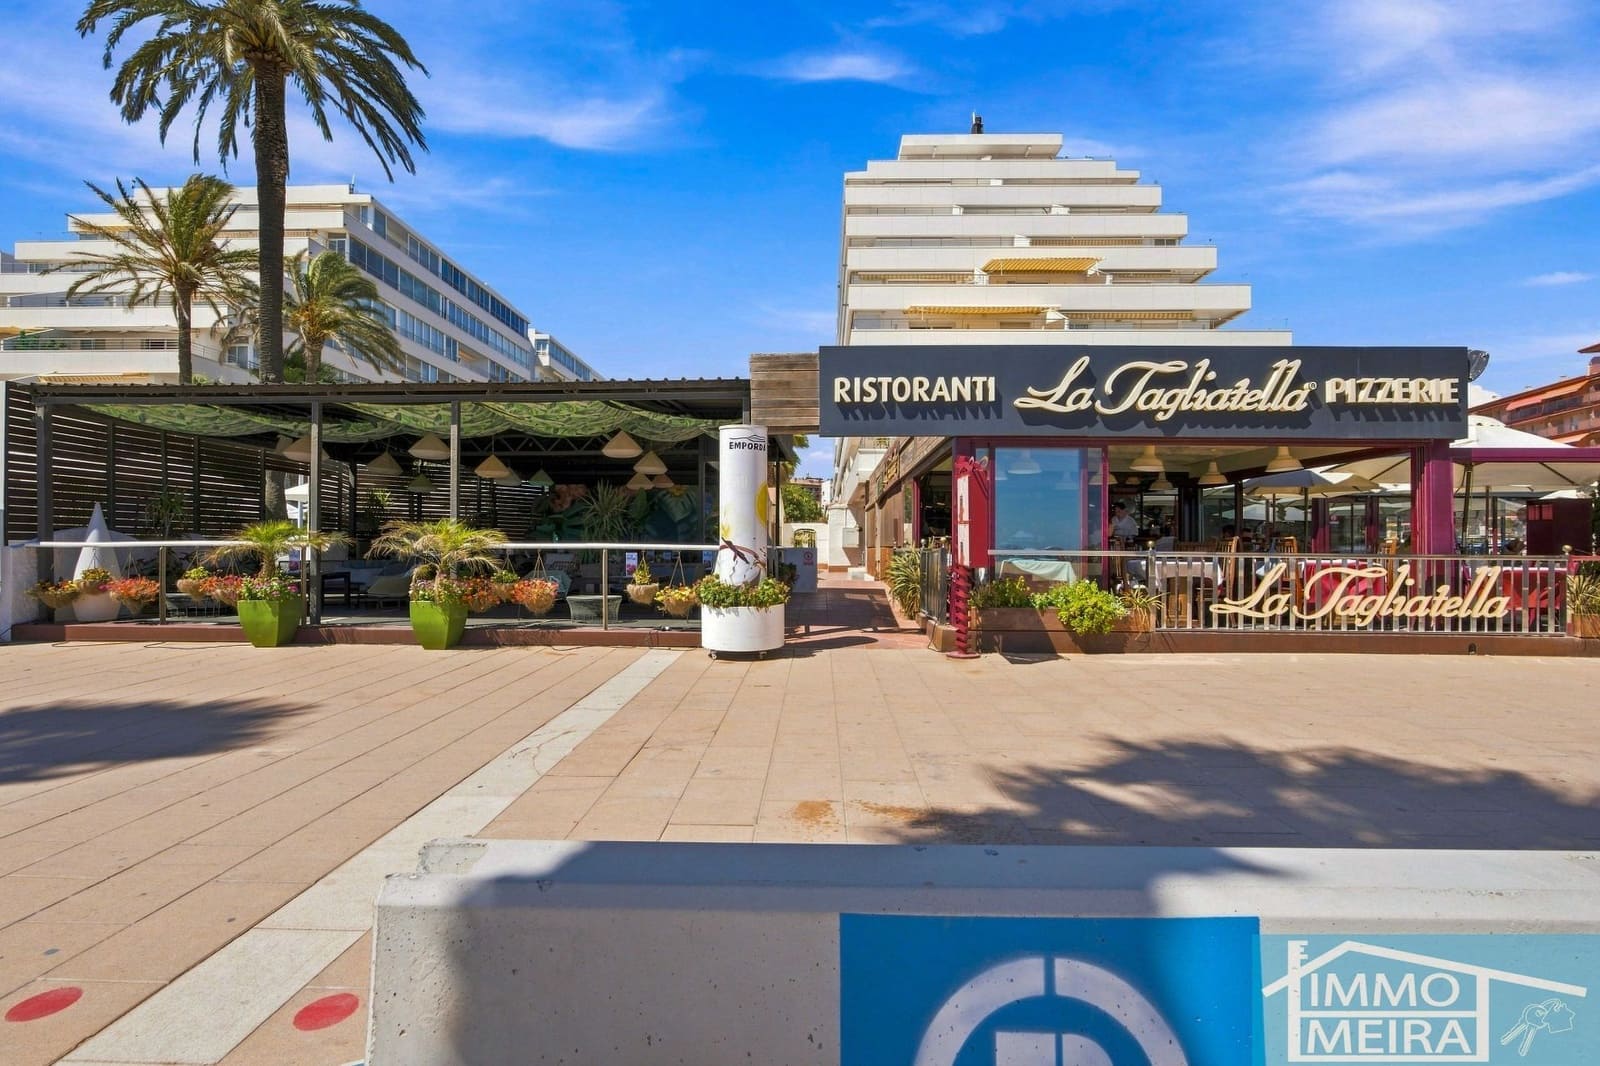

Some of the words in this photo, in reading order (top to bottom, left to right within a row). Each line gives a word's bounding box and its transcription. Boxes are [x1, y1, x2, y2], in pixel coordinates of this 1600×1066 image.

[834, 376, 996, 403] RISTORANTI
[1013, 355, 1095, 413] La
[1325, 377, 1460, 404] PIZZERIE
[1209, 562, 1292, 618] La
[1292, 564, 1511, 627] Tagliatella
